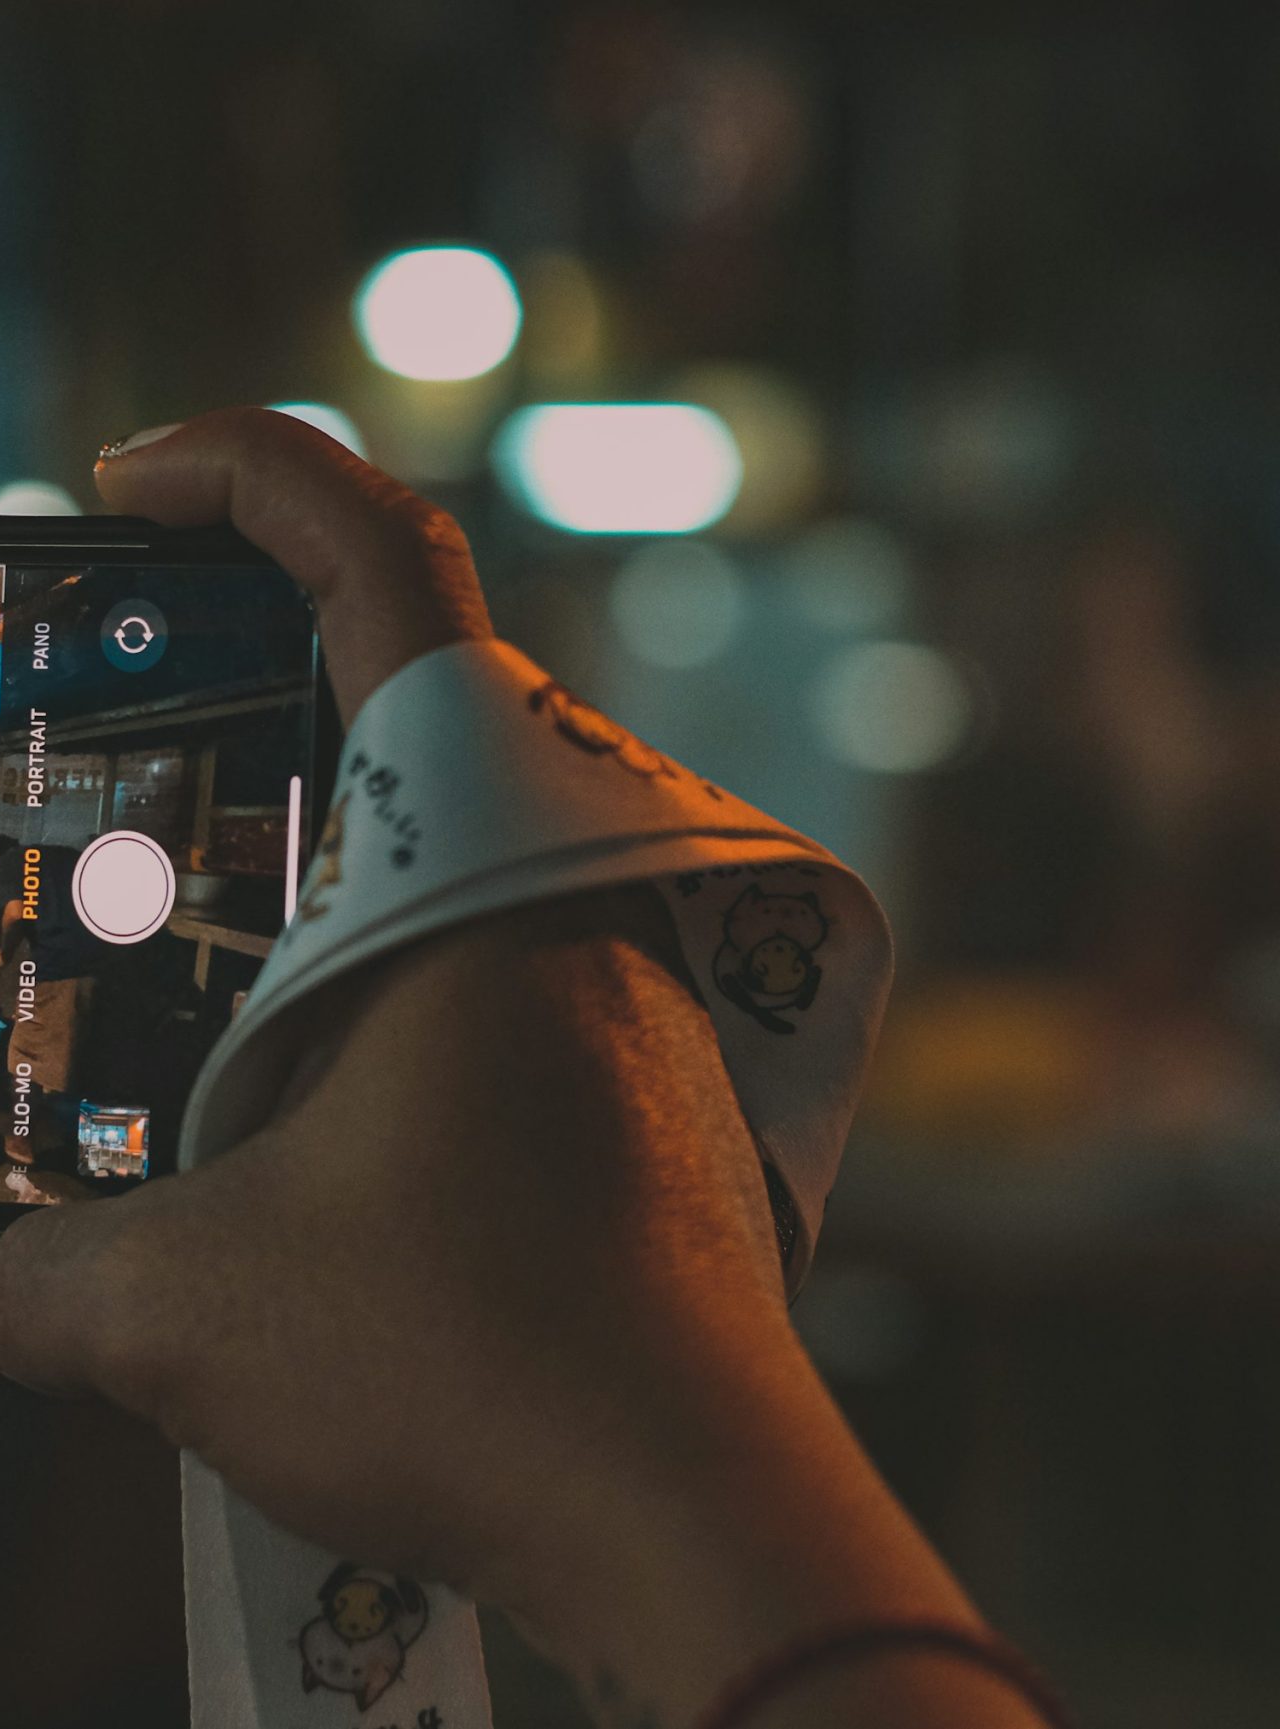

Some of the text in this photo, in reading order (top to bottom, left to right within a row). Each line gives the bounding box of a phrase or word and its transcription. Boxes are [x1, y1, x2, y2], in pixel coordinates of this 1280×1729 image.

[32, 622, 51, 670] PANO
[27, 707, 47, 807] PORTRAIT
[22, 848, 42, 920] PHOTO
[18, 960, 37, 1022] VIDEO
[13, 1062, 32, 1137] SLO-MO
